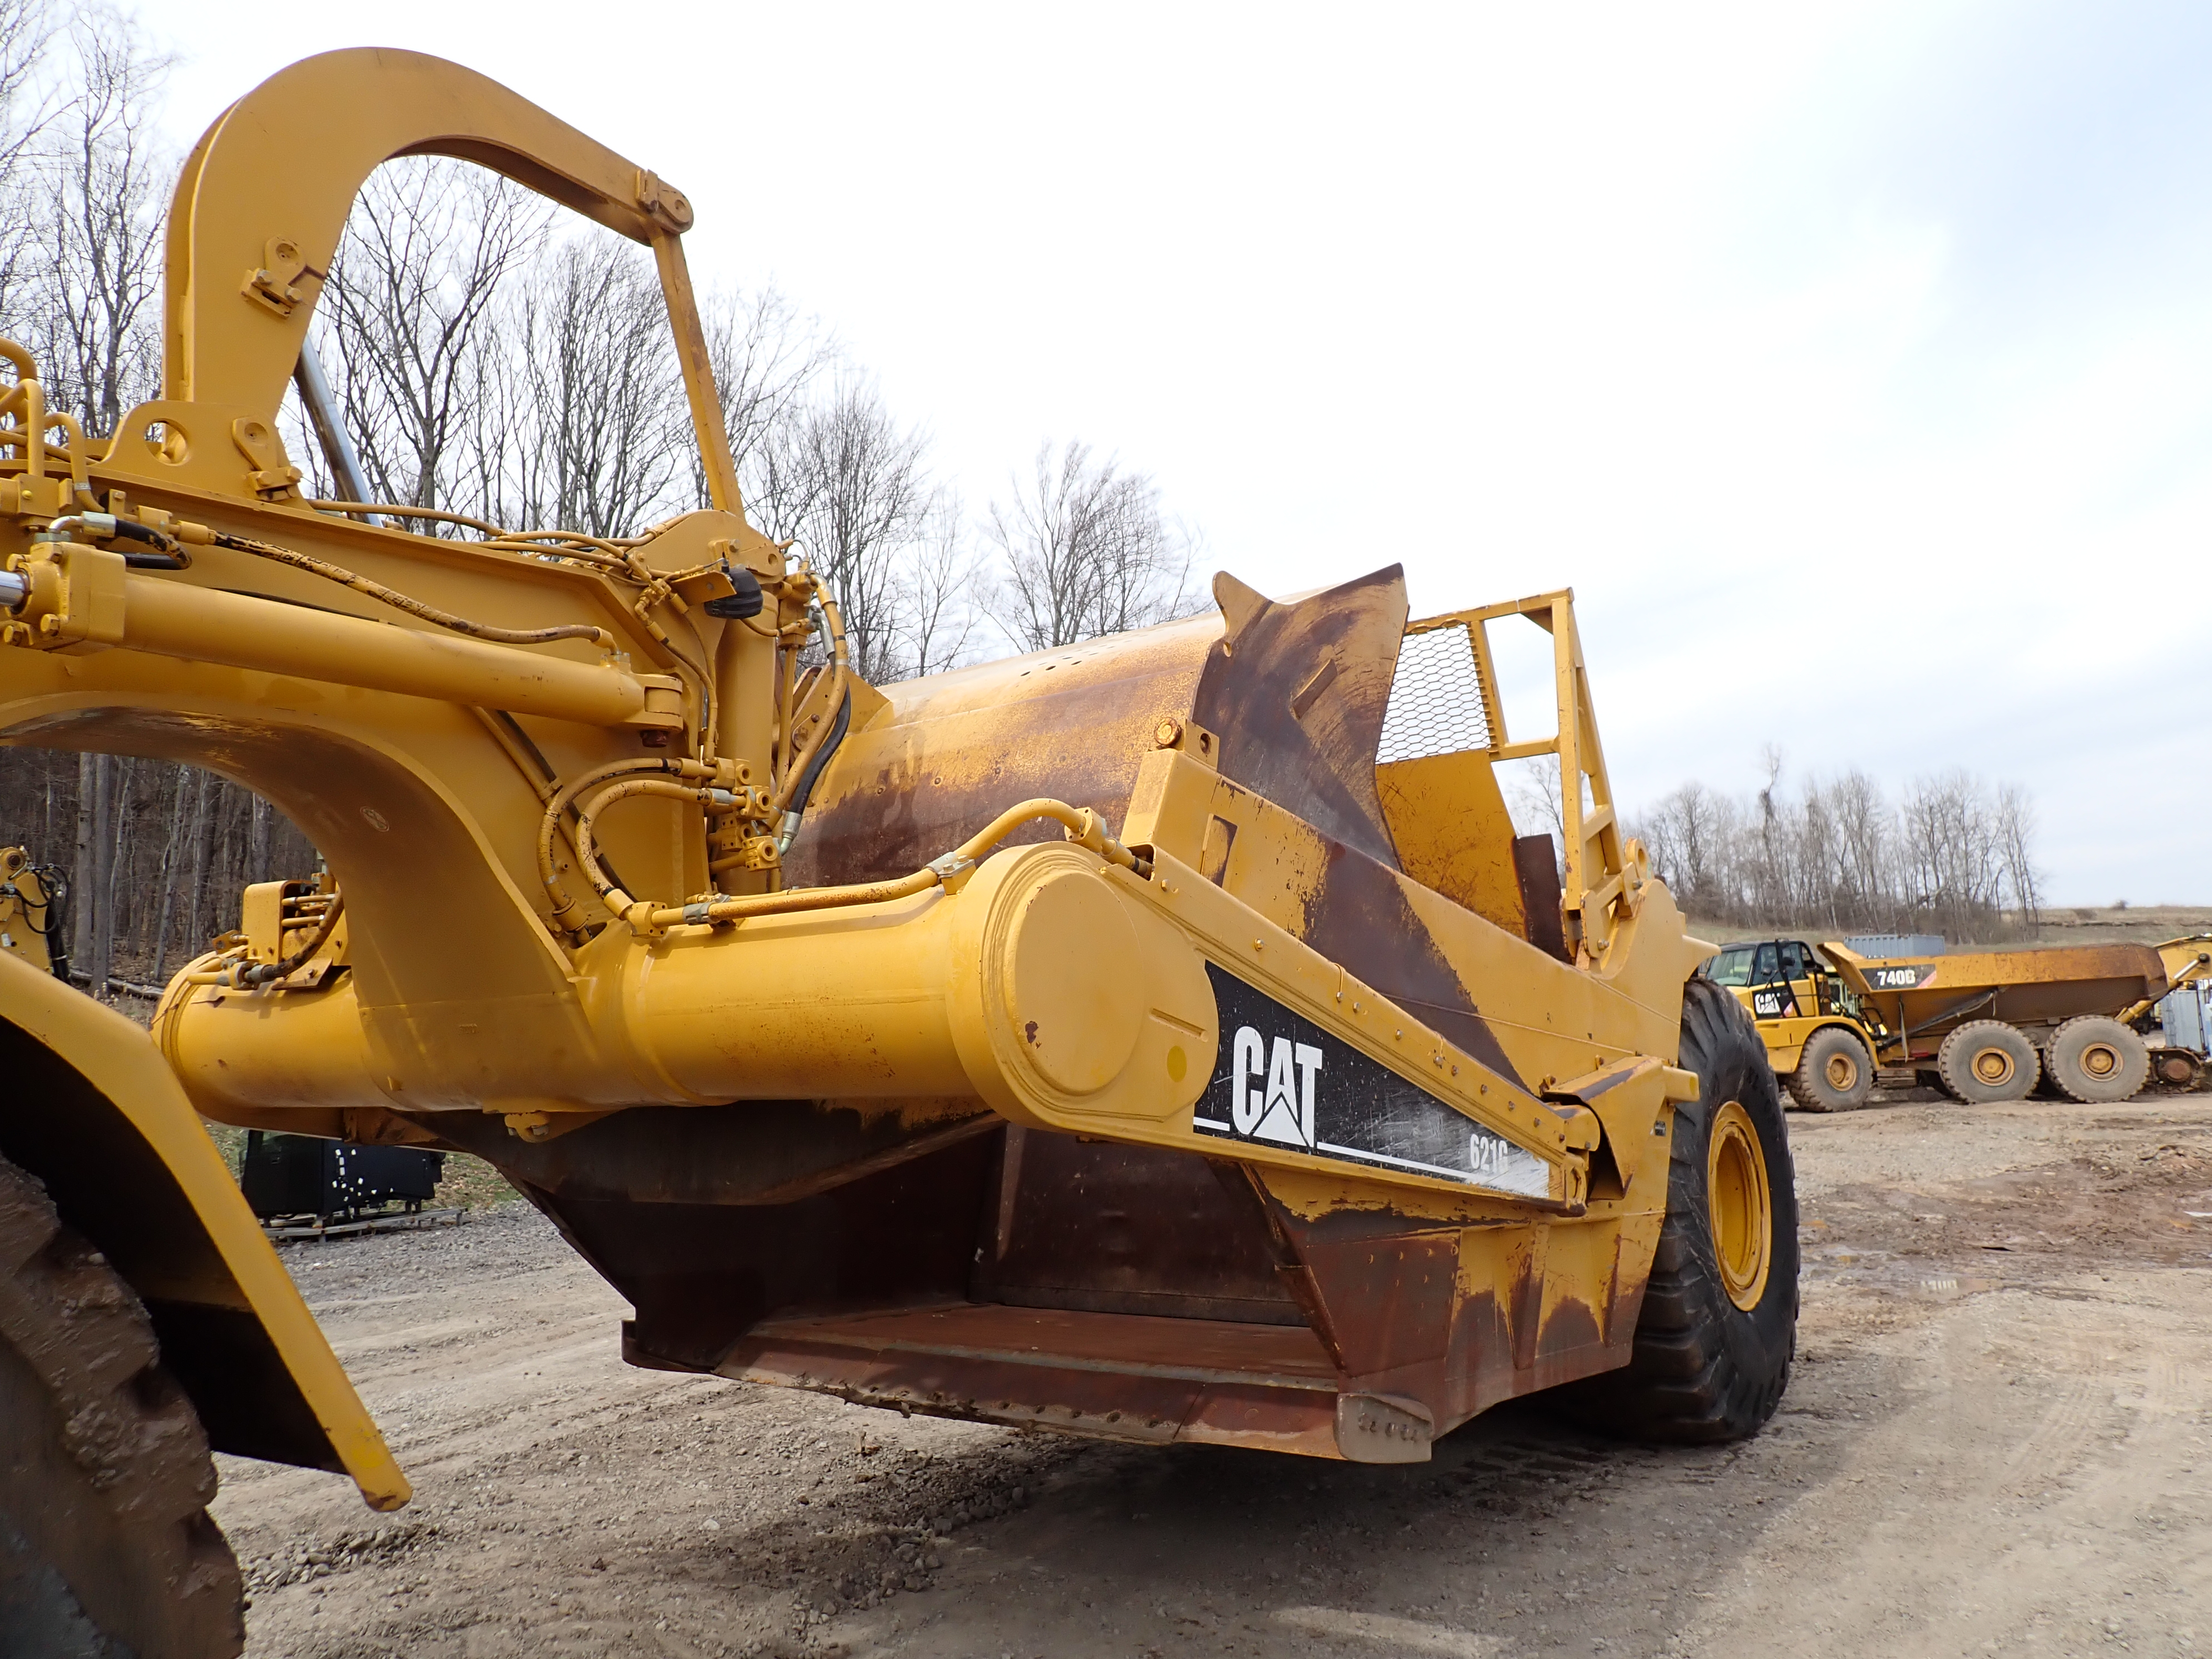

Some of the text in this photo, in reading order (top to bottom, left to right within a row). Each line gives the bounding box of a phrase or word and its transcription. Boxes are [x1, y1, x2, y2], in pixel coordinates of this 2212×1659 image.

[1877, 969, 1916, 986] 740B
[1755, 992, 1781, 1014] CAT
[1233, 1026, 1323, 1148] CAT
